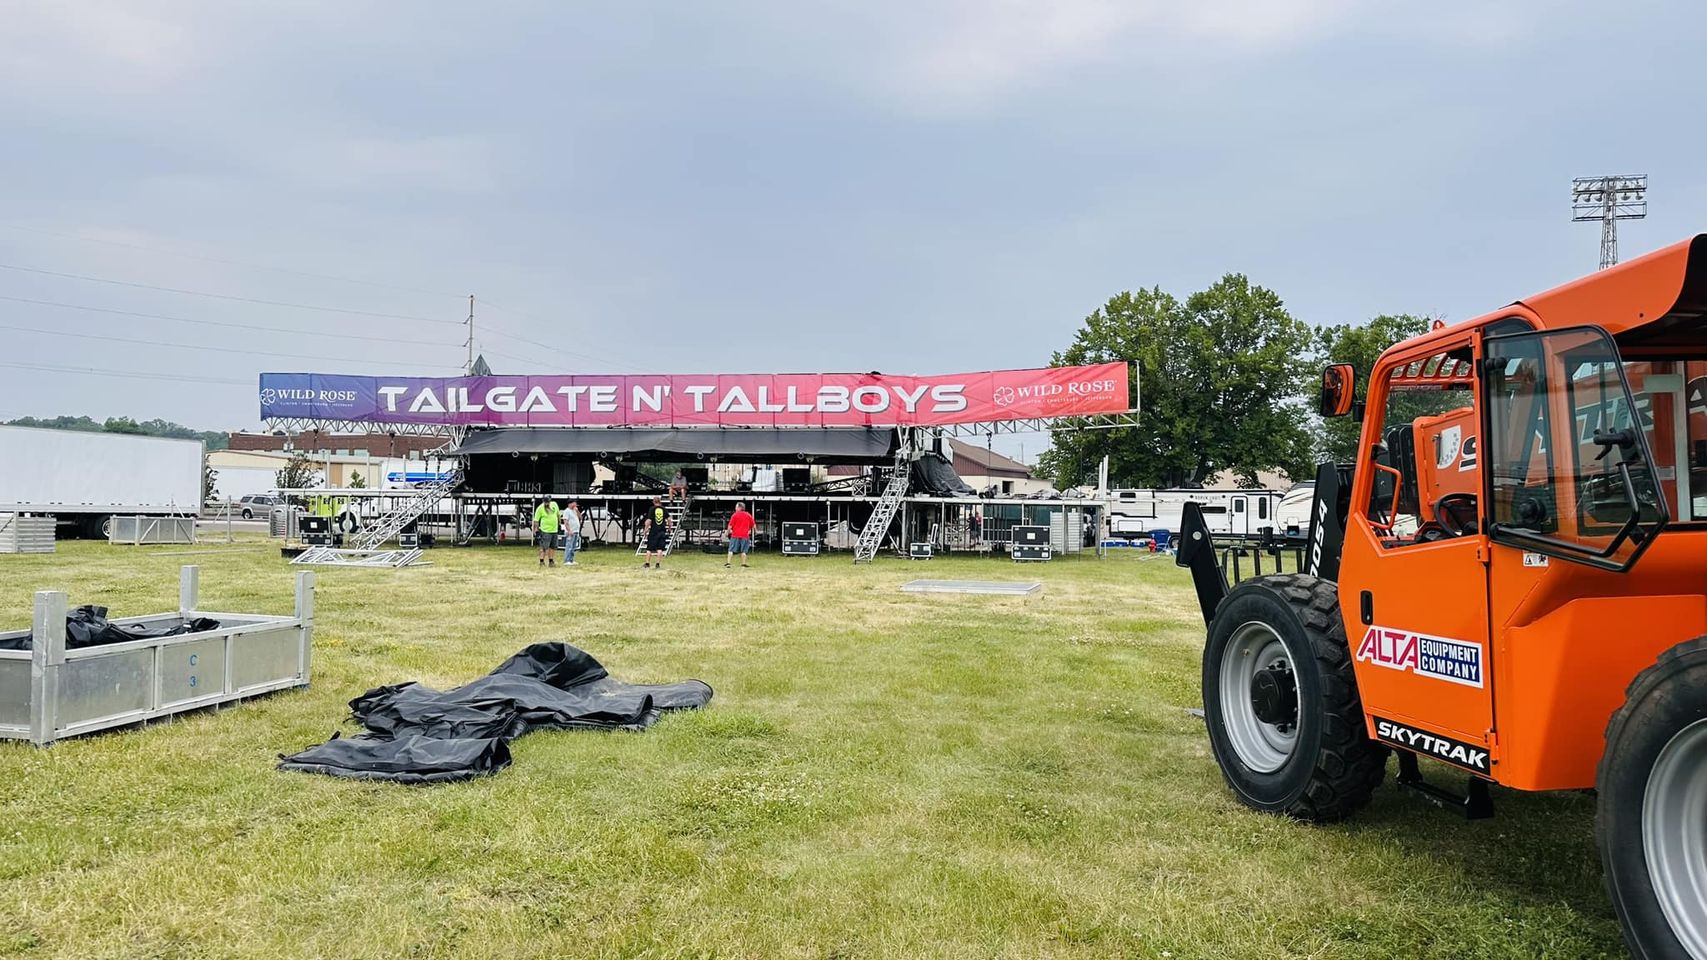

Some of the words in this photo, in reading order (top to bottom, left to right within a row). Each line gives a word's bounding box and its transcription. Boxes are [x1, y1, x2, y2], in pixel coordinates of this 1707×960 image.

[277, 388, 316, 400] WILD
[319, 390, 356, 403] ROSE
[378, 386, 619, 413] TAILGATE
[684, 384, 968, 412] TALLBOYS
[1016, 384, 1063, 398] WILD
[1068, 379, 1116, 396] ROSE
[190, 654, 198, 666] C
[1358, 628, 1419, 669] ALTA
[1421, 640, 1477, 663] EQUIPMENT
[1421, 656, 1477, 680] COMPANY
[190, 675, 197, 688] 3
[1377, 721, 1488, 769] SKYTRAK
